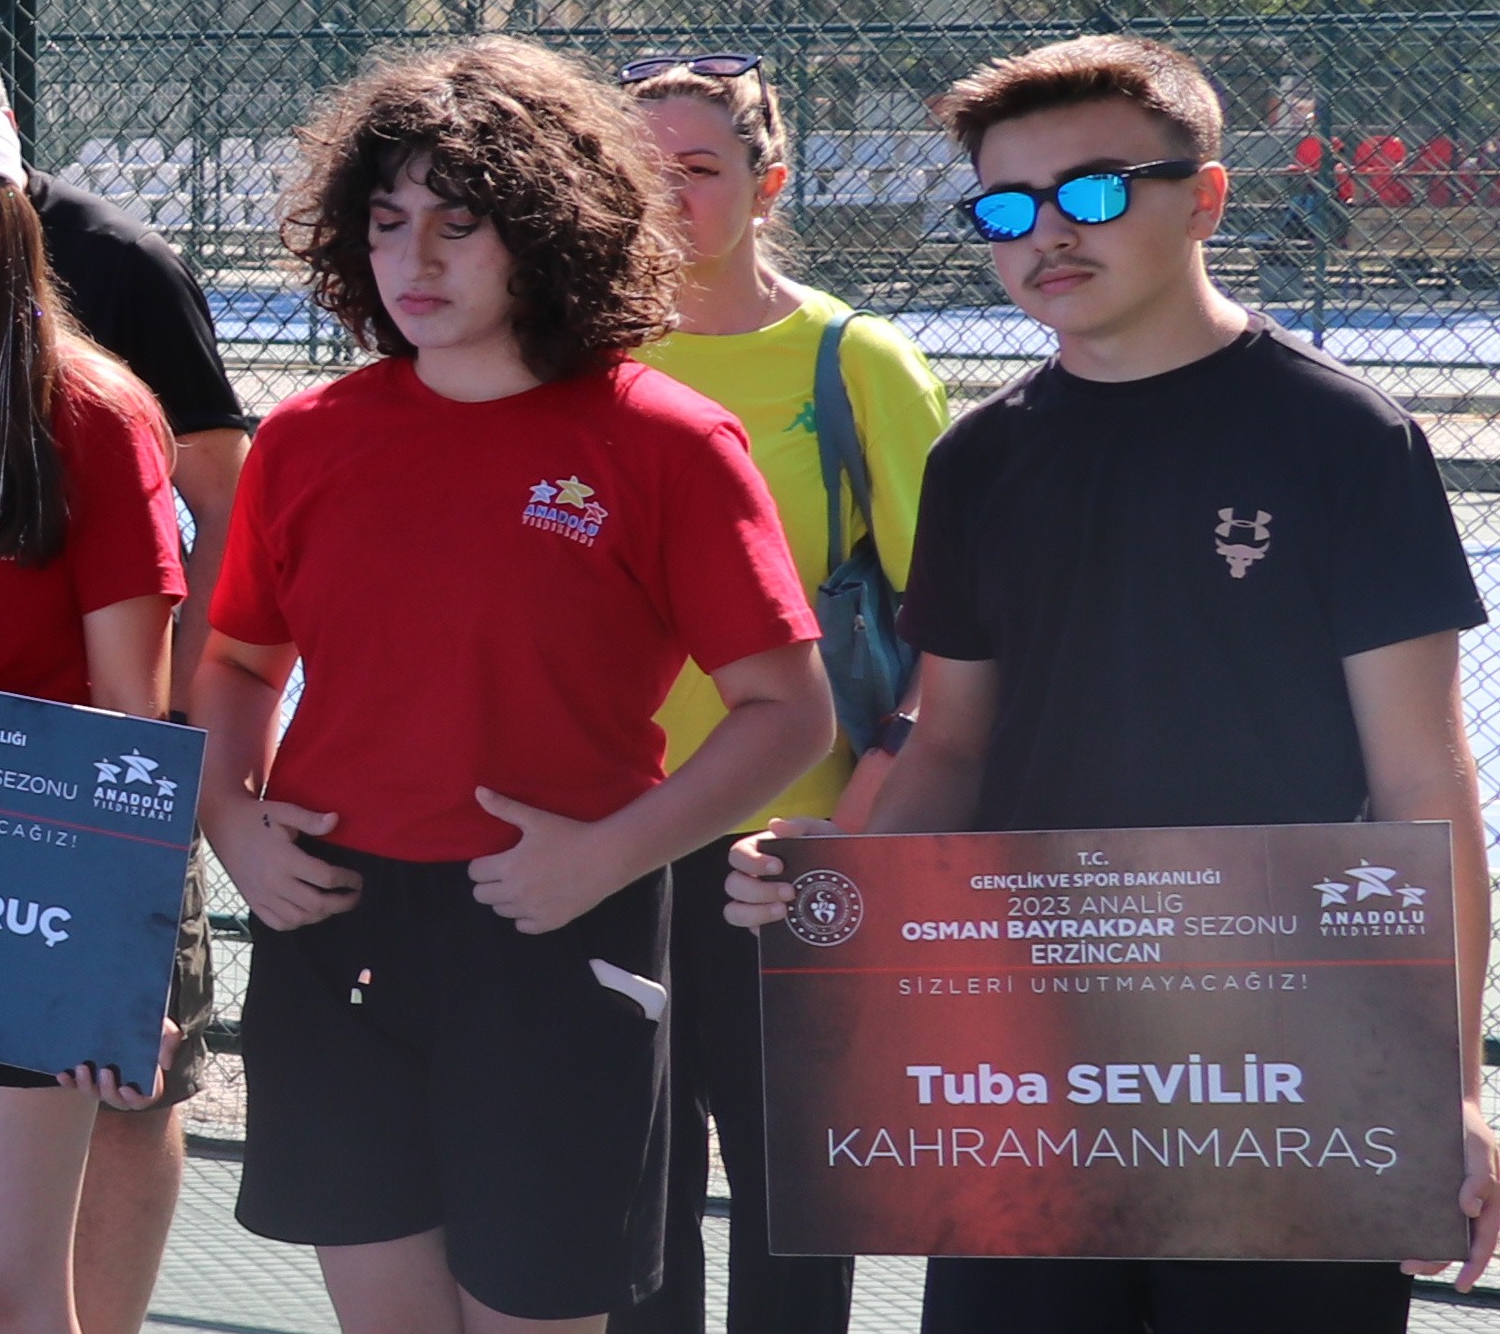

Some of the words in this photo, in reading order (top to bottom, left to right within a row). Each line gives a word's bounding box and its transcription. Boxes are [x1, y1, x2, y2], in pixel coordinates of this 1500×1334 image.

[522, 515, 594, 547] YILDIZLARI
[523, 504, 599, 536] ANADOLU
[94, 787, 173, 812] ANADOLU
[1078, 851, 1108, 865] T.C.
[970, 871, 1044, 890] GENÇLİK
[1047, 874, 1070, 887] VE
[1073, 873, 1121, 887] SPOR
[1124, 868, 1221, 885] BAKANLIĞI
[1007, 896, 1071, 916] 2023
[1080, 891, 1183, 915] ANALİG
[902, 919, 999, 940] OSMAN
[1007, 917, 1174, 938] BAYRAKDAR
[1184, 915, 1298, 935] SEZONU
[1320, 910, 1425, 926] ANADOLU
[1031, 940, 1162, 964] ERZİNCAN
[899, 974, 1014, 994] SİZLERİ
[1031, 969, 1308, 993] UNUTMAYACAĞIZ!
[906, 1064, 1047, 1104] Tuba
[1067, 1054, 1304, 1103] SEVİLİR
[828, 1127, 1398, 1176] KAHRAMANMARAŞ
